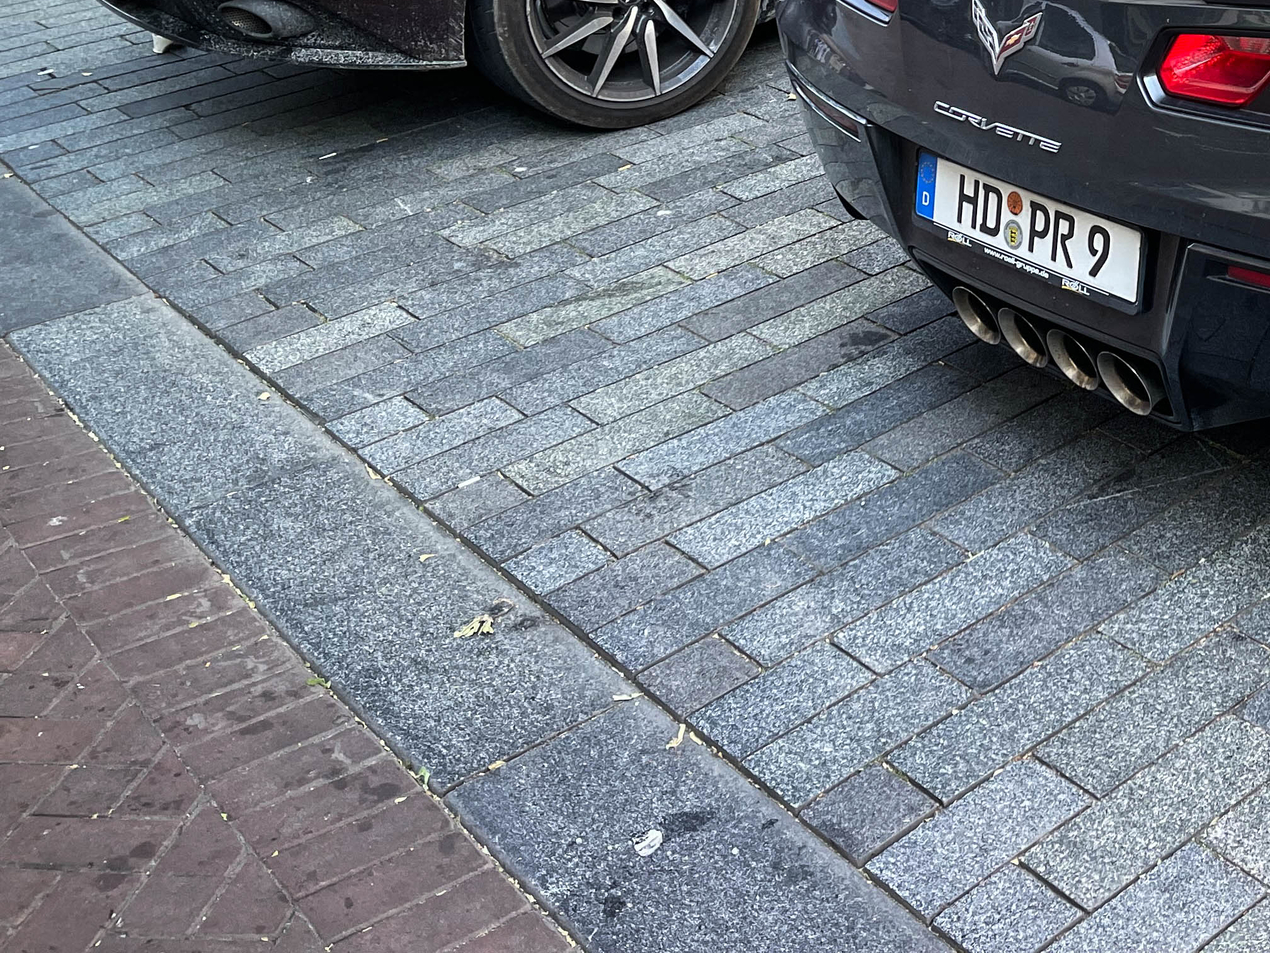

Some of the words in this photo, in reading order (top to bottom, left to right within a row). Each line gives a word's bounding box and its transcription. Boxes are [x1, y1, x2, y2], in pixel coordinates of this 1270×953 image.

[933, 100, 1063, 153] CORVETTE
[921, 190, 931, 206] D
[957, 173, 1003, 238] HD
[1027, 200, 1076, 270] PR
[1087, 224, 1111, 278] 9
